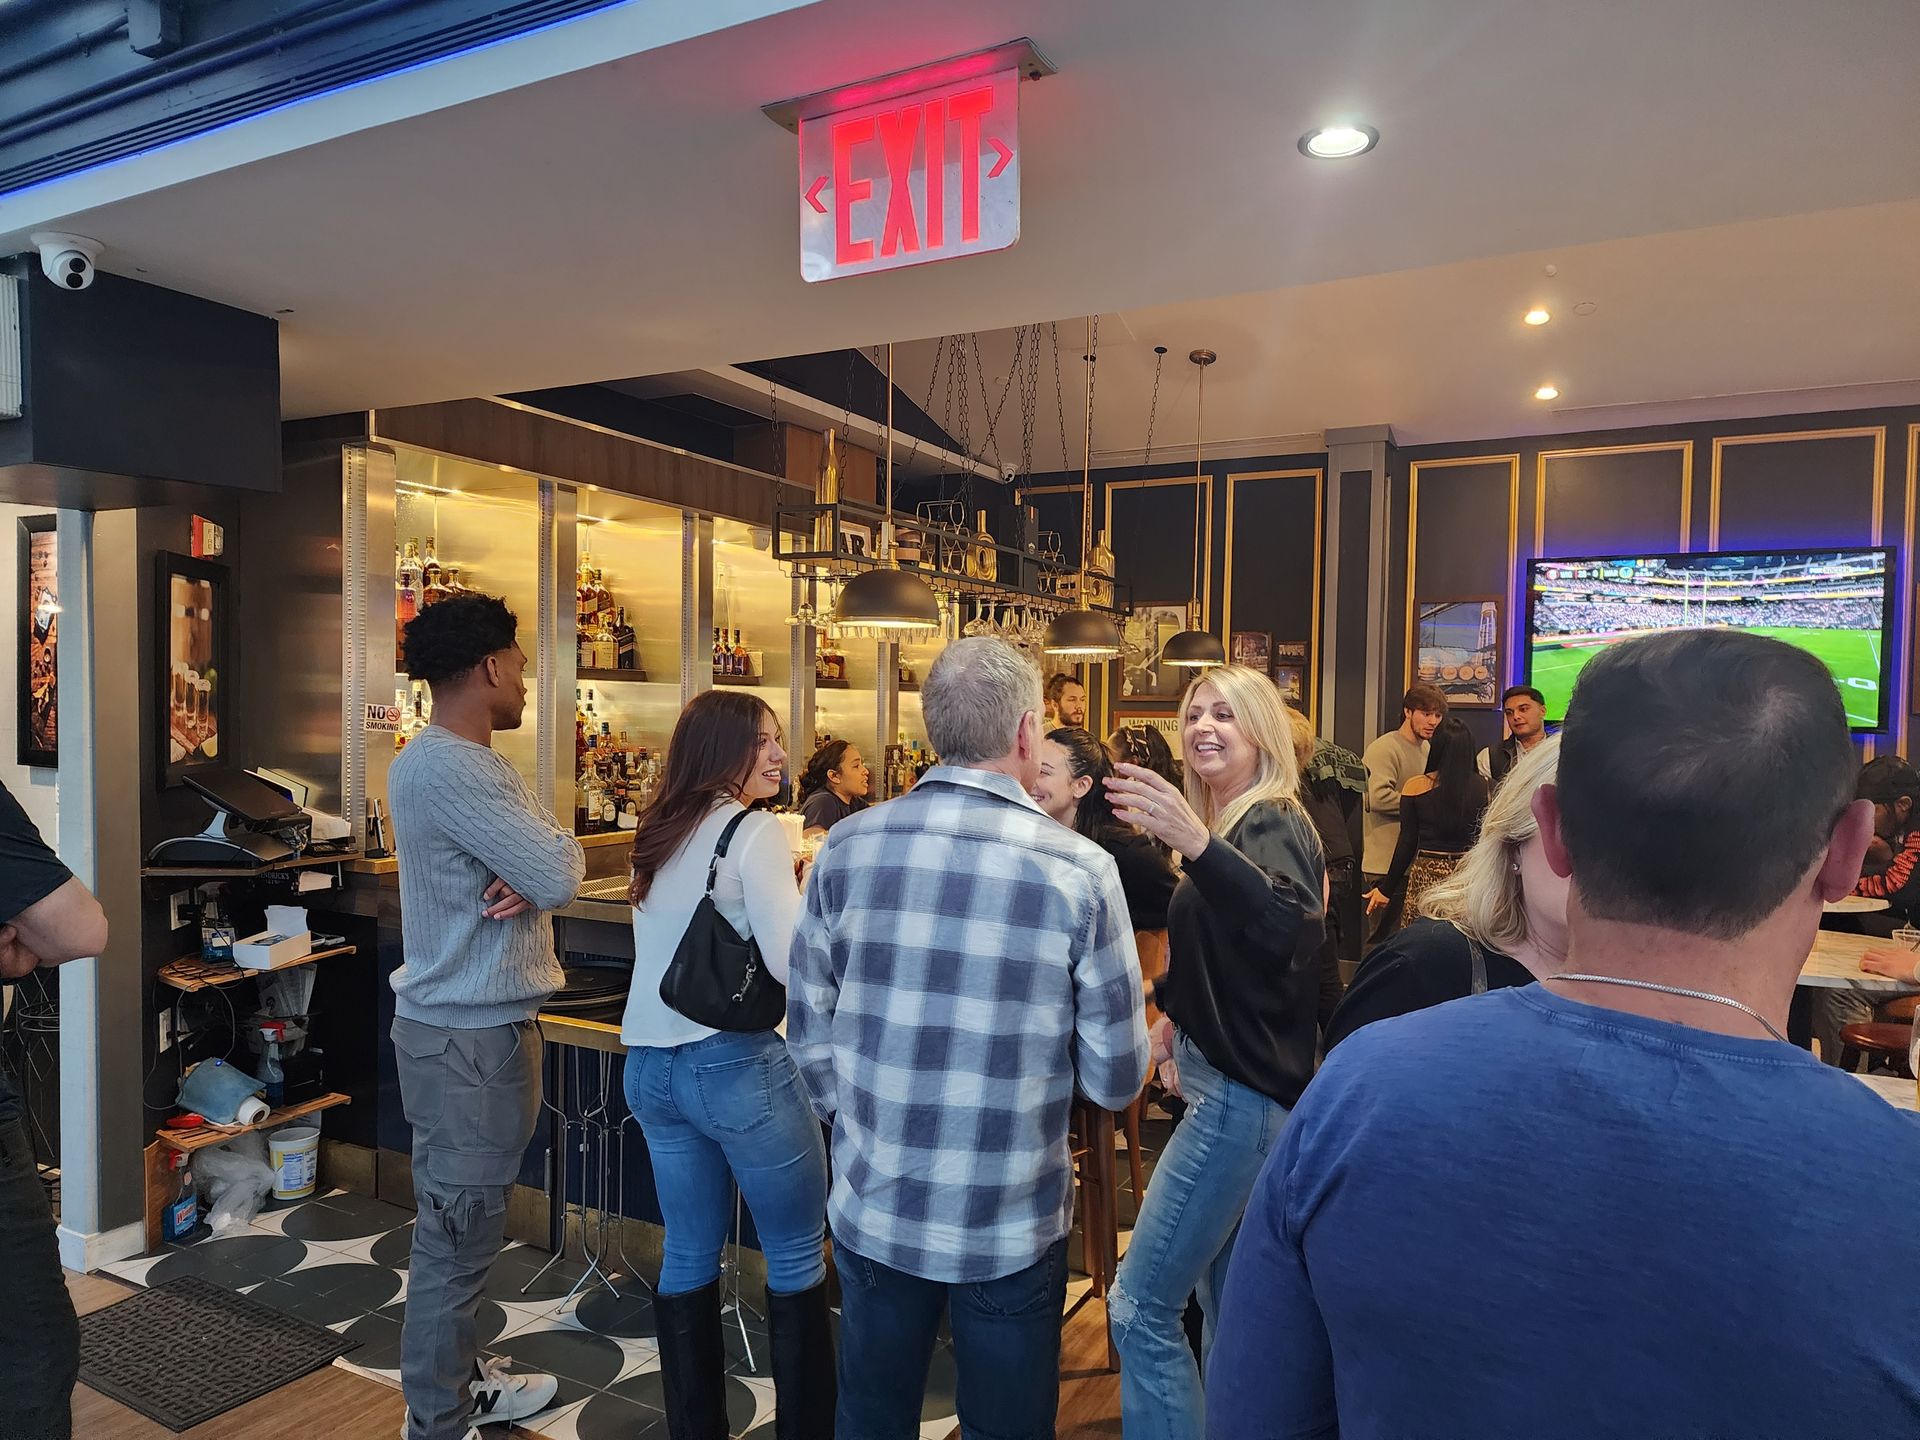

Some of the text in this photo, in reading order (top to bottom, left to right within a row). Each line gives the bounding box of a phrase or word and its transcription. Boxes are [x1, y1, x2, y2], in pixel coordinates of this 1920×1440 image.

[832, 85, 994, 264] EXIT
[840, 532, 865, 557] AR
[367, 705, 386, 720] NO
[365, 721, 399, 731] SMOKING
[471, 1391, 502, 1415] N
